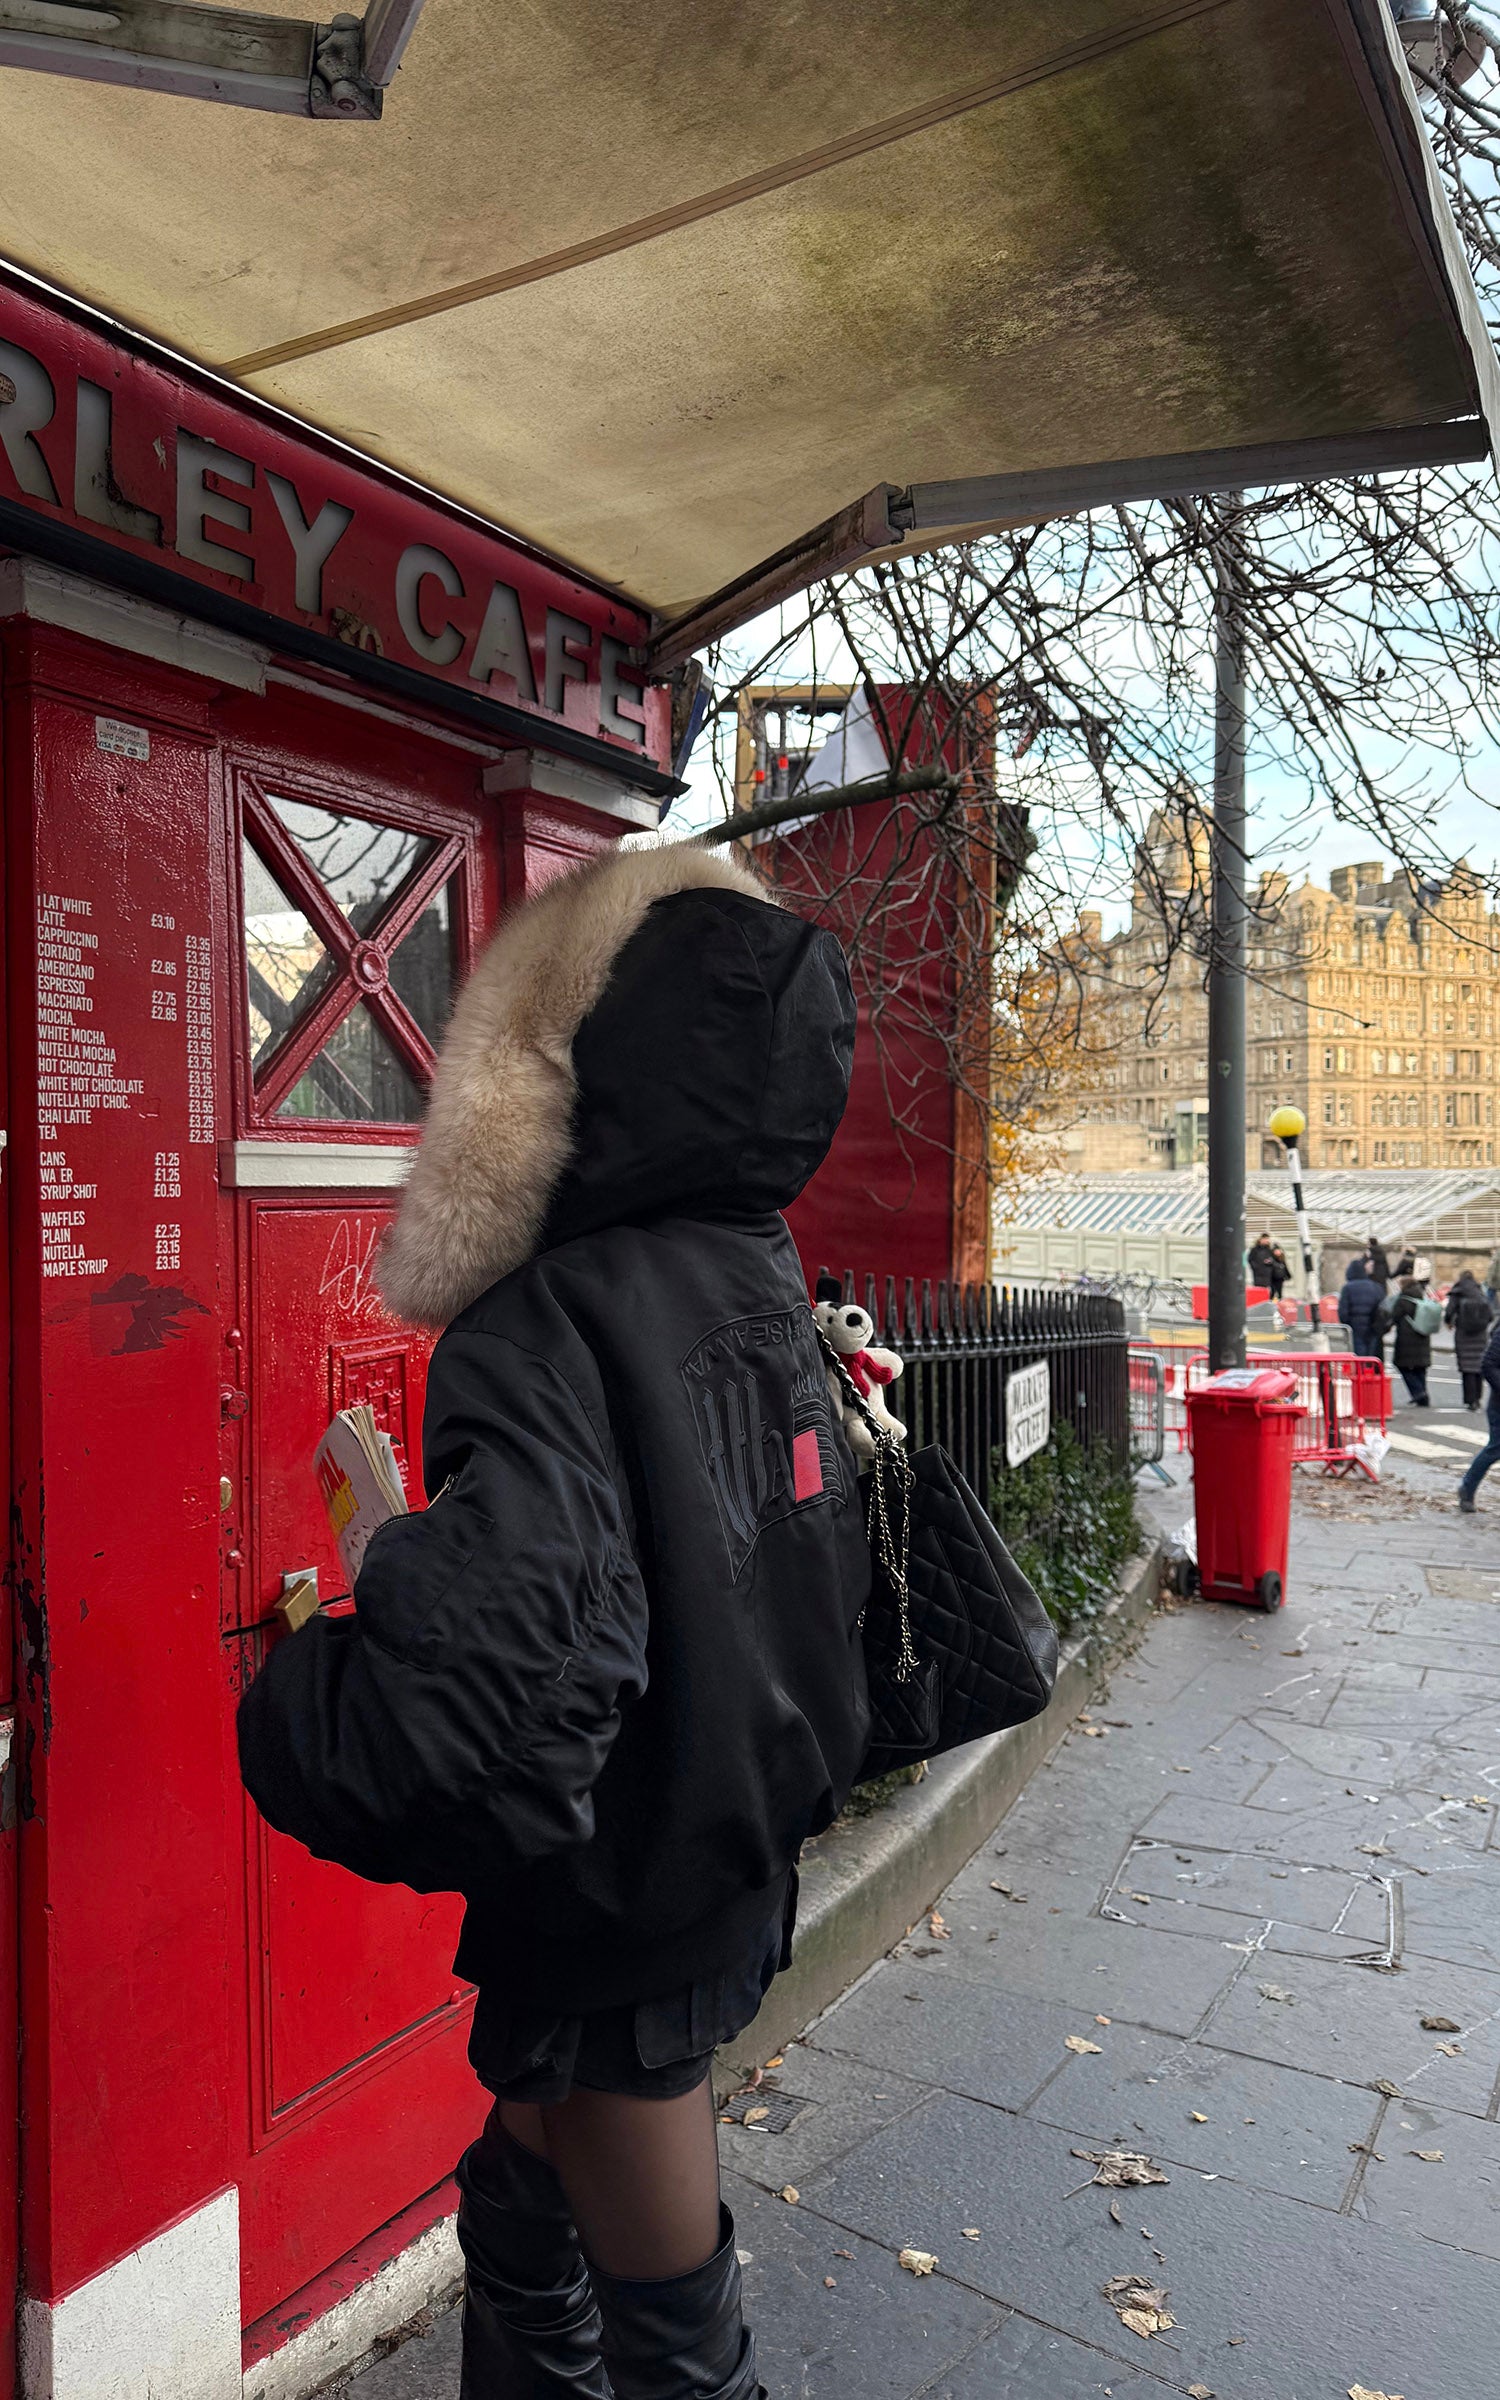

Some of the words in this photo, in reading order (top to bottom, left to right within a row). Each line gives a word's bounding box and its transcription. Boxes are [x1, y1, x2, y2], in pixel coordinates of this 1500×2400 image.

[62, 897, 92, 916] WHITE
[151, 914, 175, 930] £3.10
[37, 909, 65, 927] LATTE
[185, 935, 210, 950] £3.35
[37, 926, 98, 949] CAPPUCCINO
[185, 950, 210, 965] £3.35
[37, 942, 81, 962] CORTADO
[151, 960, 176, 976] £2.85
[187, 965, 210, 980] £3.15
[37, 959, 94, 980] AMERICANO
[186, 981, 210, 995] £2.95
[37, 975, 85, 995] ESPRESSO
[152, 991, 176, 1006] £2.75
[186, 996, 211, 1010] £2.95
[37, 992, 92, 1012] MACCHIATO
[151, 1007, 177, 1021] £2.85
[186, 1010, 211, 1025] £3.05
[37, 1025, 69, 1041] WHITE
[72, 1028, 105, 1045] MOCHA
[187, 1041, 211, 1055] £3.55
[186, 1026, 211, 1040] £3.45
[37, 1041, 79, 1059] NUTELLA
[83, 1045, 116, 1062] MOCHA
[187, 1057, 212, 1070] £3.75
[38, 1058, 57, 1072] HOT
[60, 1059, 113, 1077] CHOCOLATE
[188, 1071, 212, 1084] £3.15
[39, 1076, 68, 1091] WHITE
[71, 1077, 89, 1092] HOT
[92, 1079, 144, 1094] CHOCOLATE
[189, 1086, 213, 1099] £3.25
[39, 1093, 80, 1108] NUTELLA
[82, 1094, 101, 1108] HOT
[103, 1095, 131, 1109] CHOC.
[189, 1101, 213, 1113] £3.55
[38, 1109, 62, 1123] CHAI
[64, 1110, 92, 1124] LATTE
[189, 1116, 214, 1128] £3.25
[39, 1125, 57, 1140] TEA
[189, 1130, 214, 1143] £2.35
[40, 1152, 65, 1166] CANS
[155, 1153, 179, 1166] £1.25
[155, 1168, 179, 1182] £1.25
[41, 1185, 71, 1200] SYRUP
[74, 1185, 97, 1199] SHOT
[154, 1183, 180, 1198] £0.50
[41, 1211, 85, 1227] WAFFLES
[42, 1228, 70, 1243] PLAIN
[43, 1244, 85, 1261] NUTELLA
[156, 1240, 180, 1254] £3.15
[43, 1261, 76, 1277] MAPLE
[78, 1259, 108, 1274] SYRUP
[156, 1256, 180, 1270] £3.15
